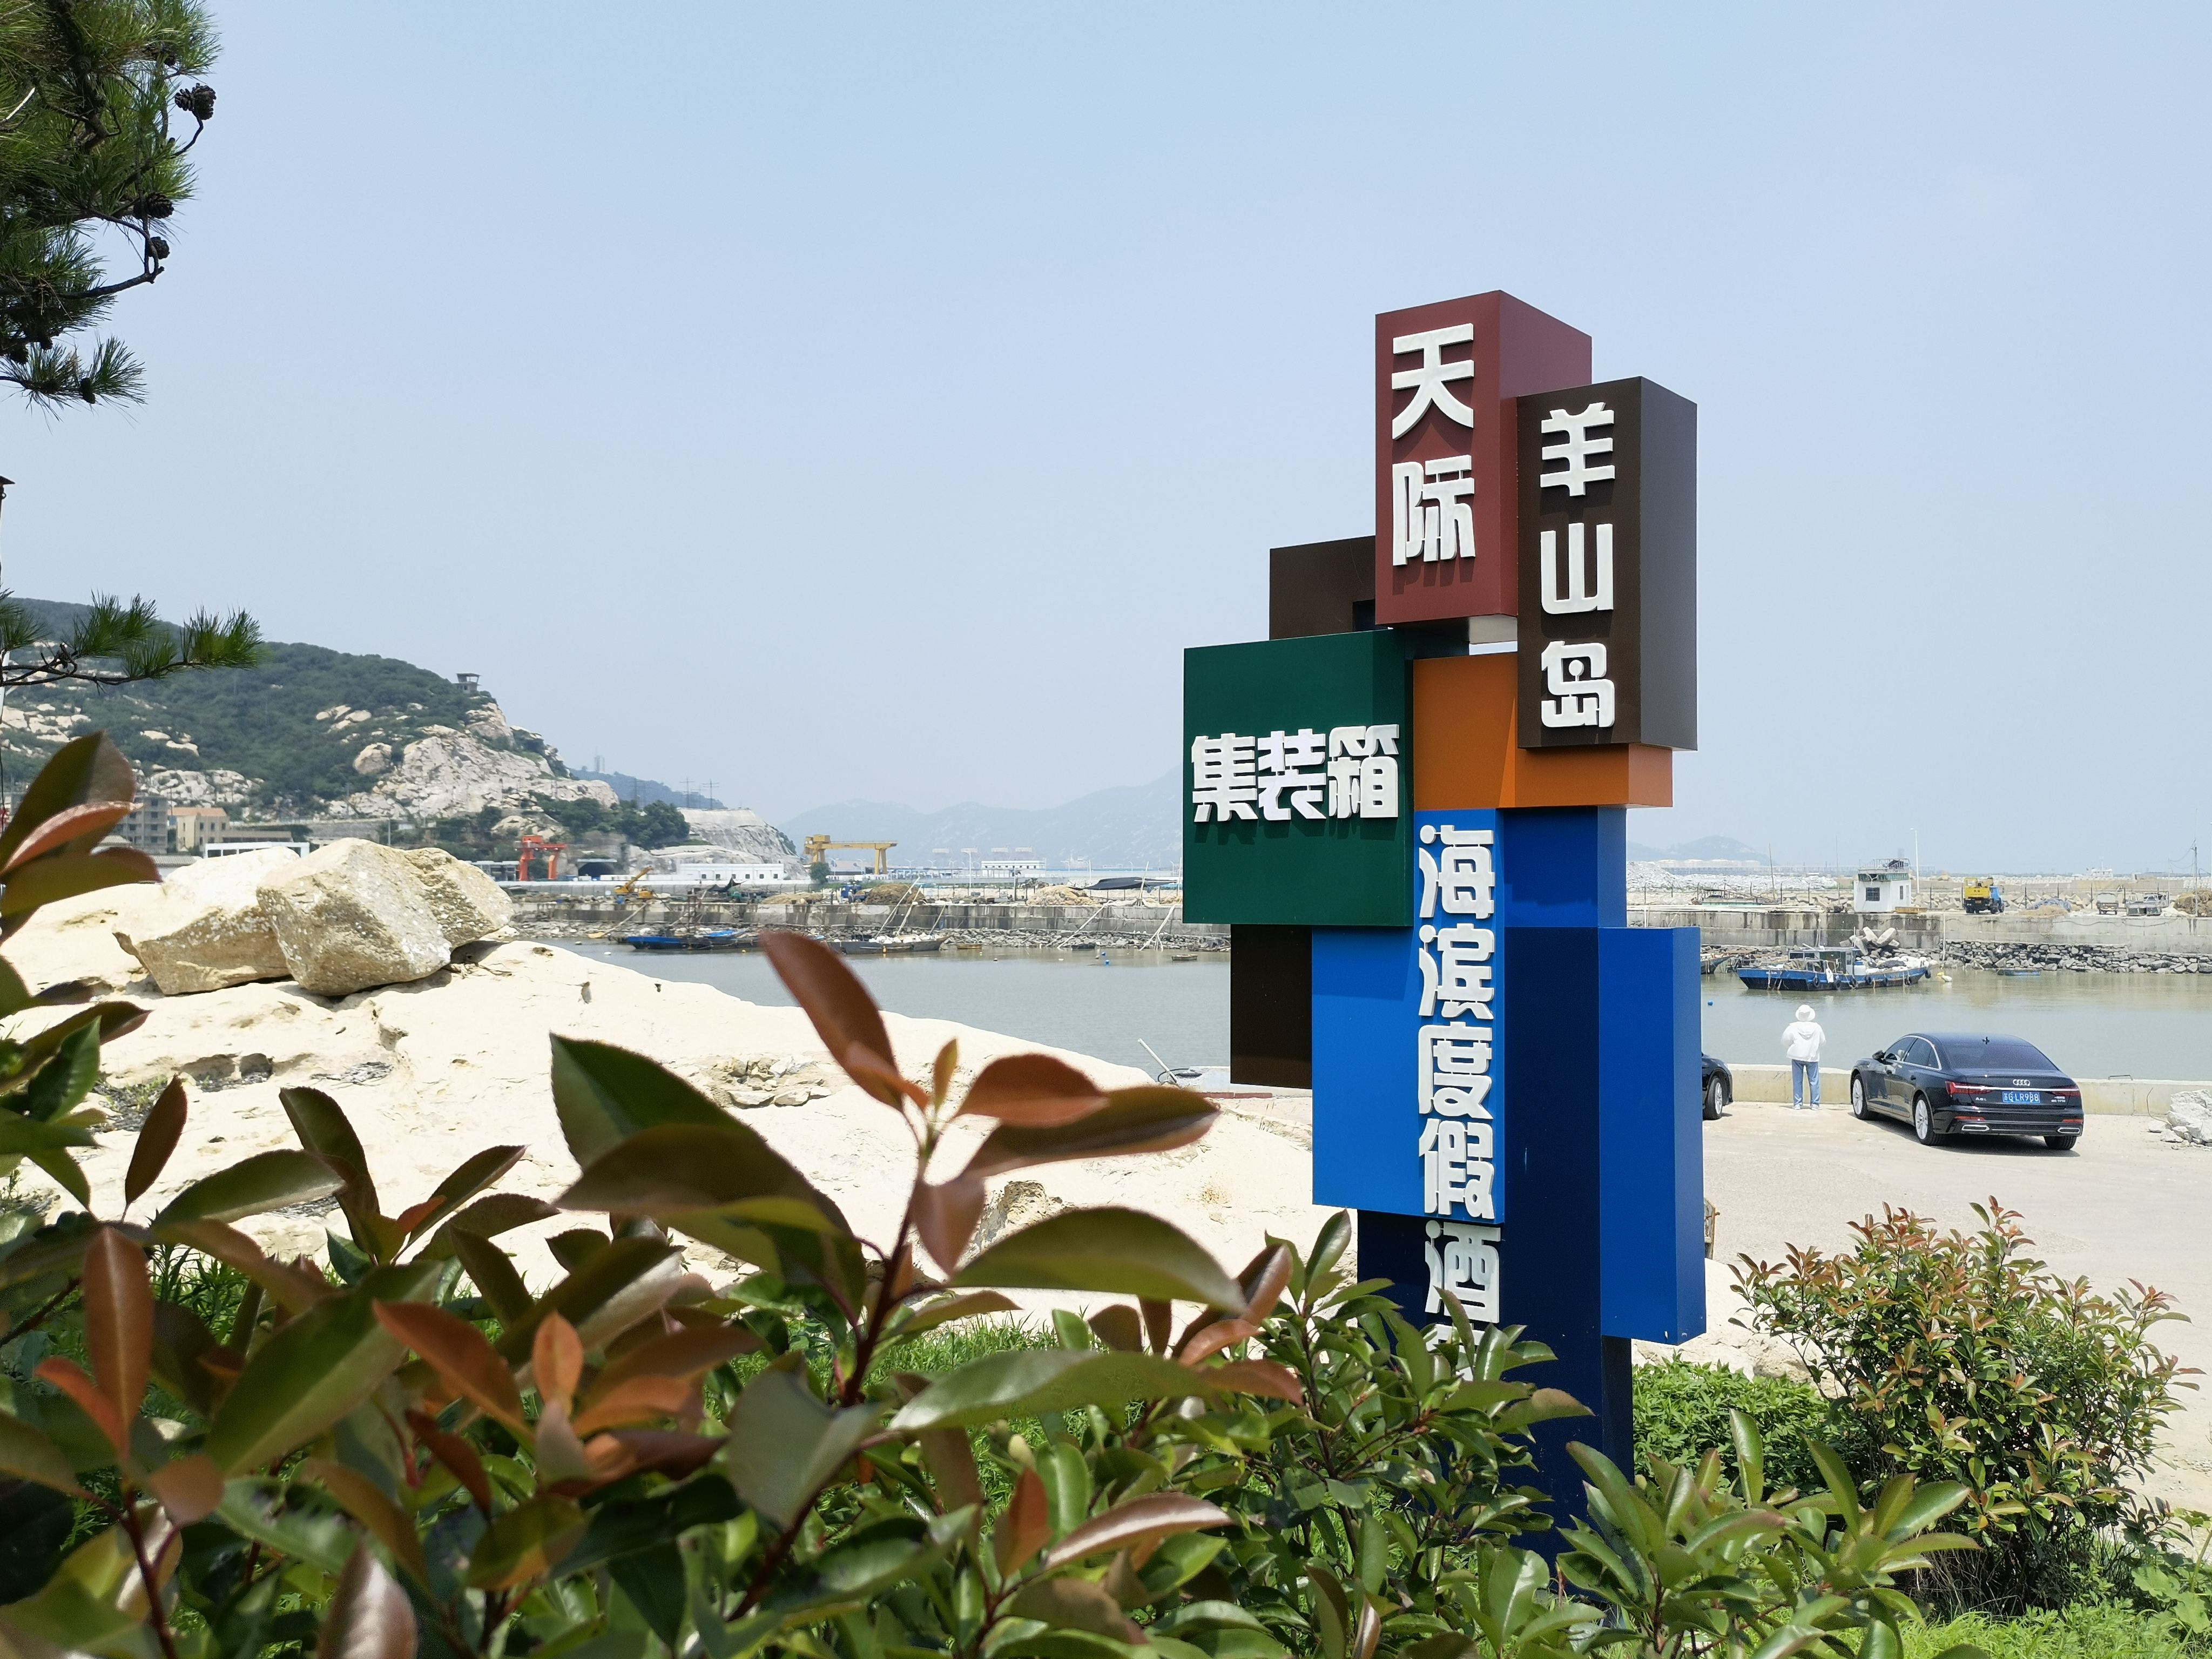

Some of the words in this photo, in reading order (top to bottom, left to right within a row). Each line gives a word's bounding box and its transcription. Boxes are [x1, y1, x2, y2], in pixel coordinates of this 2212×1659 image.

[1391, 323, 1475, 566] 天际
[1540, 402, 1615, 727] 羊山岛
[1191, 724, 1399, 822] 集装箱
